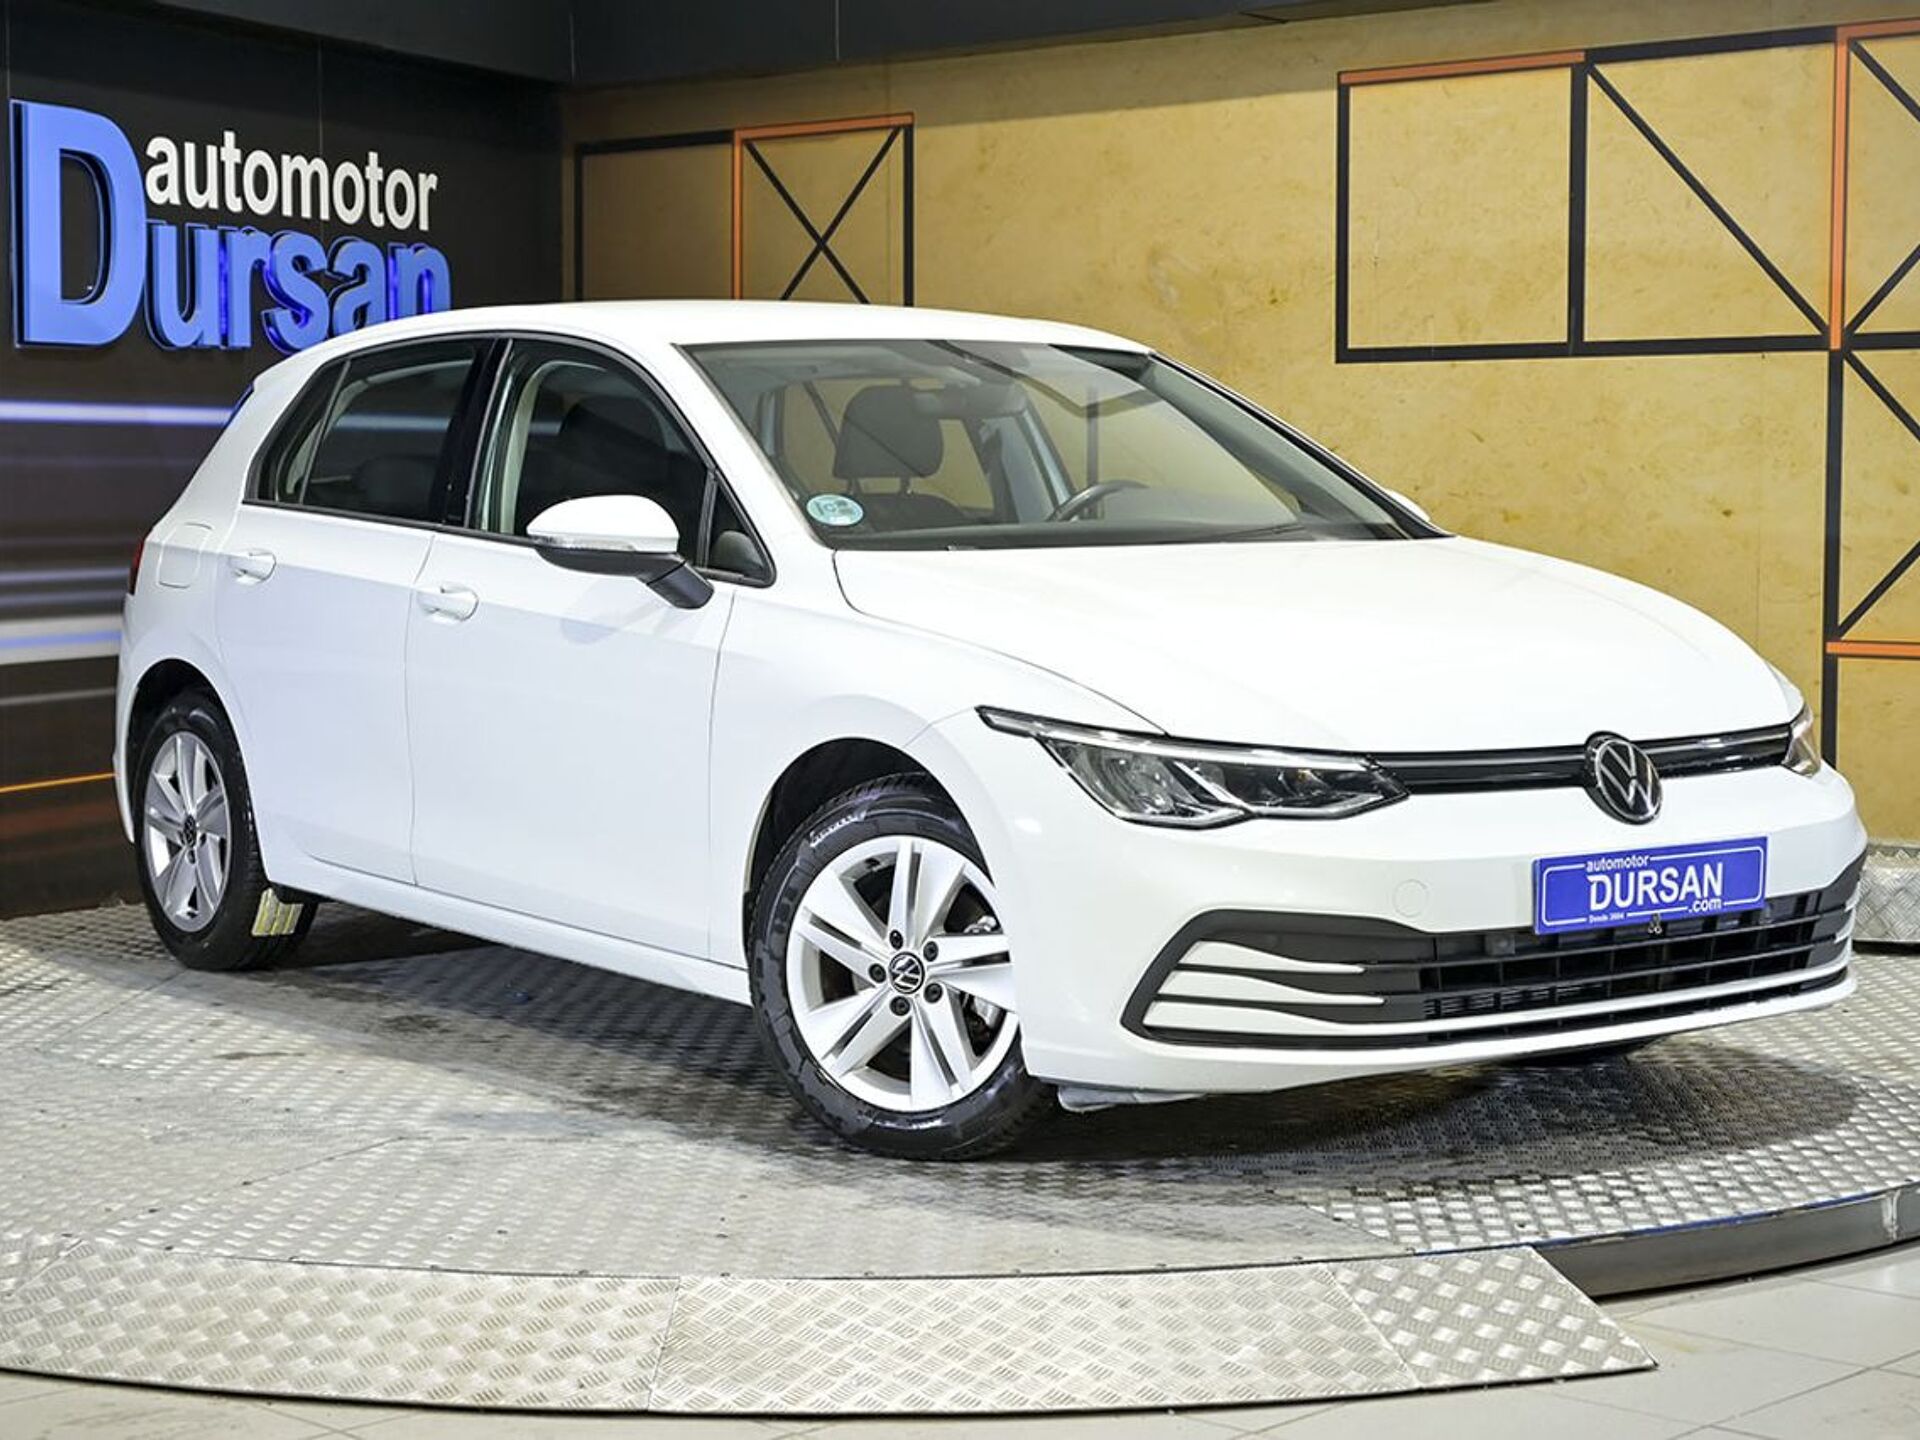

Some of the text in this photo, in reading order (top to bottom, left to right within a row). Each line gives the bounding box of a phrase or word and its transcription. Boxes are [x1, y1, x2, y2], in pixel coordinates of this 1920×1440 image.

[145, 130, 438, 232] automotor
[11, 99, 451, 354] Dursan
[1586, 854, 1649, 873] automotor
[1586, 863, 1723, 911] DURSAN
[1688, 898, 1723, 914] .com
